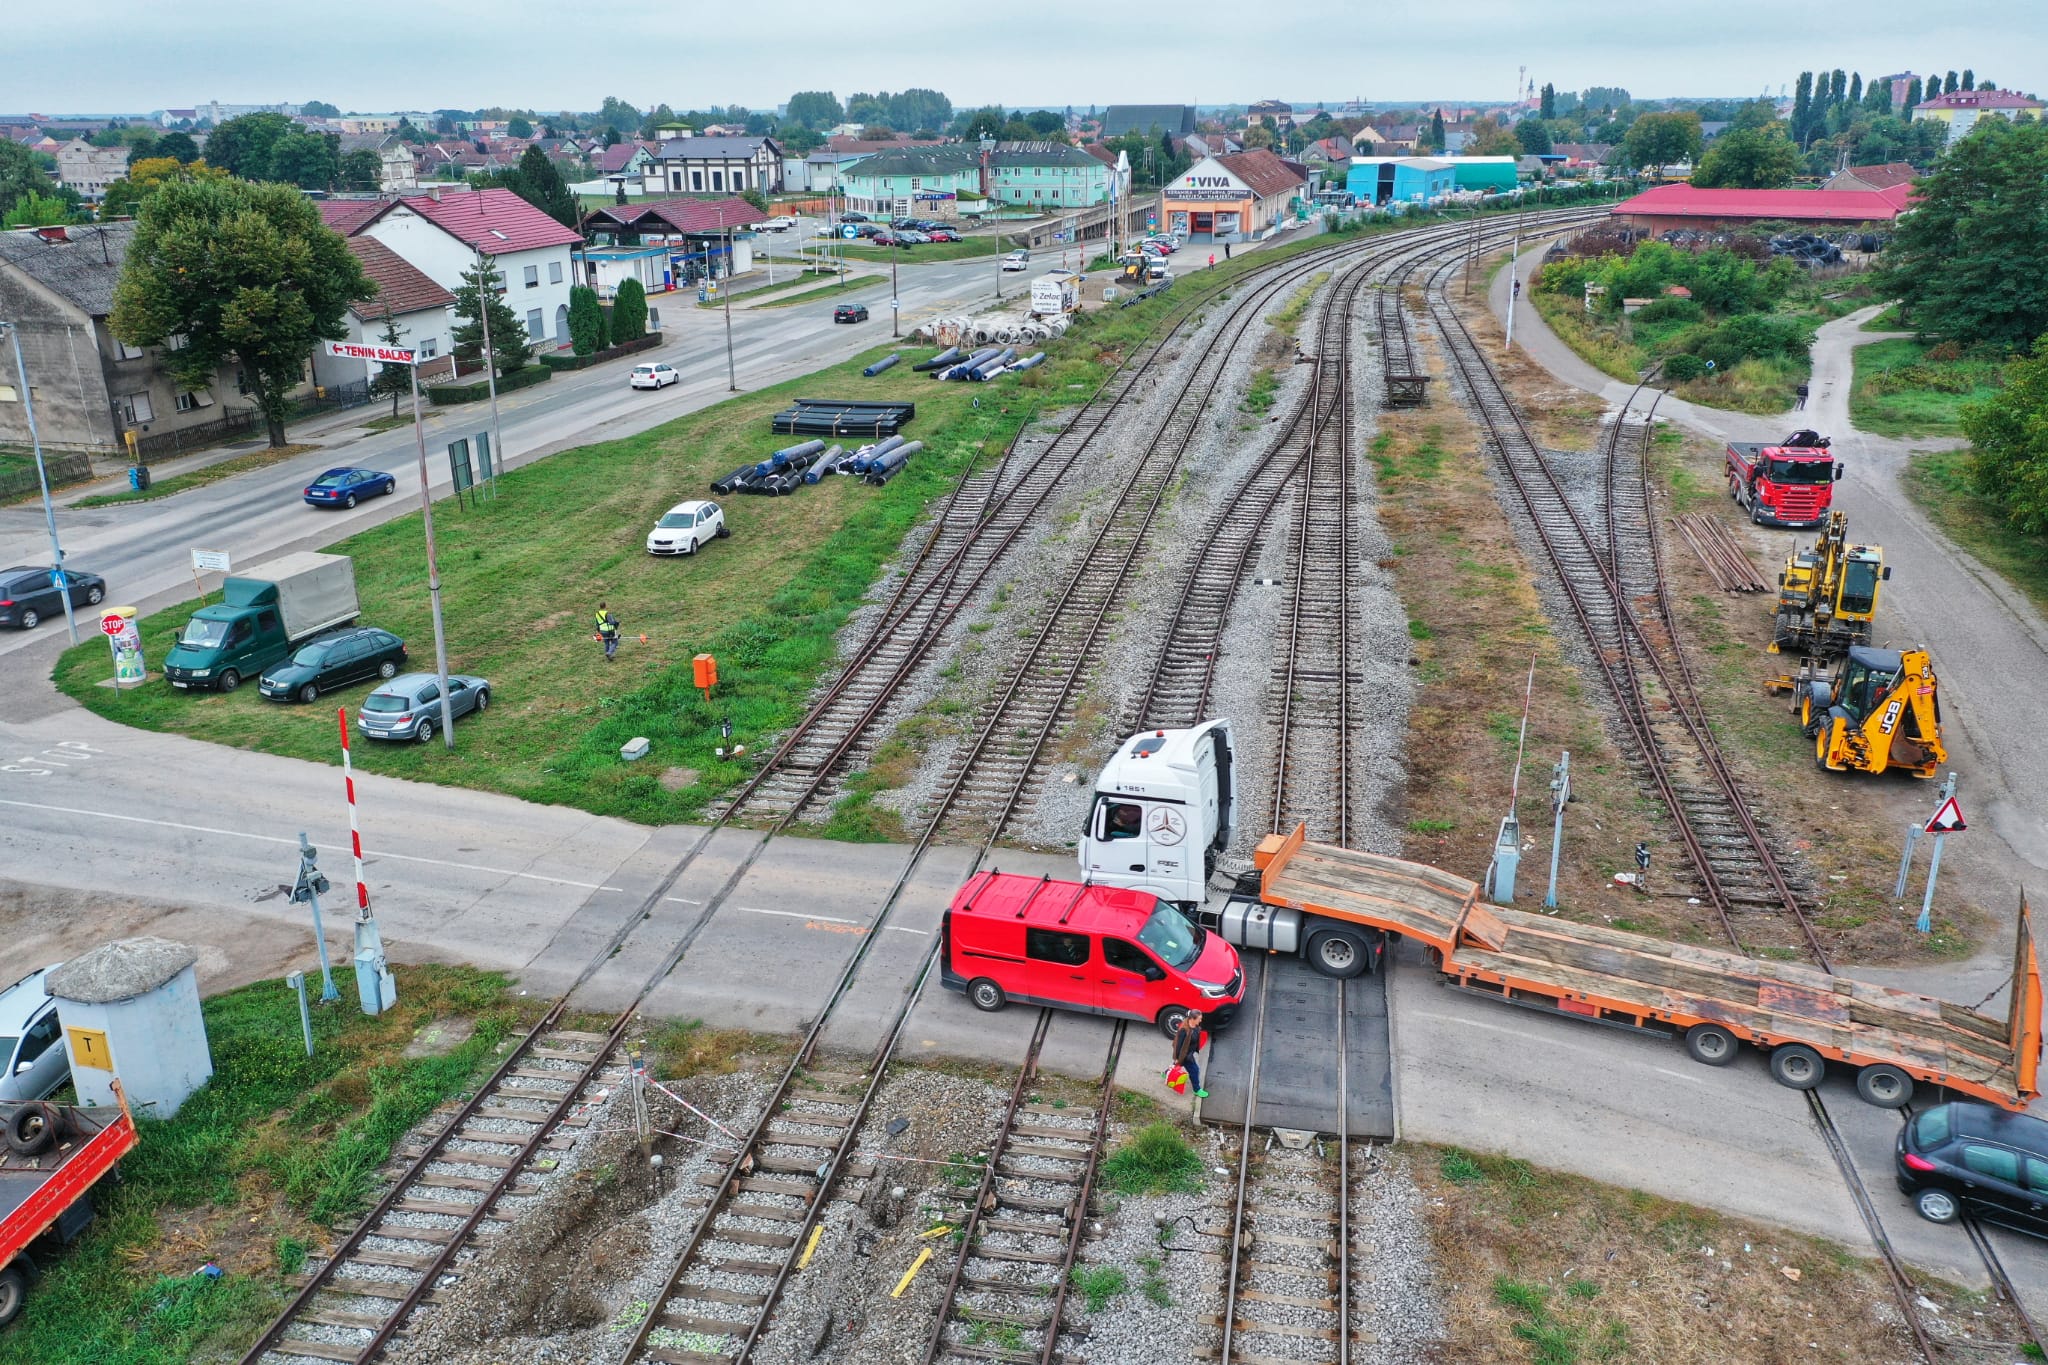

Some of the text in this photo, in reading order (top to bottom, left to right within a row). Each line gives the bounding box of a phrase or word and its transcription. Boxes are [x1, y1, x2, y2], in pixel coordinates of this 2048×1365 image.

[1197, 176, 1230, 187] VIVA
[344, 345, 375, 358] TENIN
[102, 620, 123, 630] STOP
[1881, 701, 1901, 734] JCB
[0, 741, 105, 776] STOP
[82, 1037, 92, 1053] T
